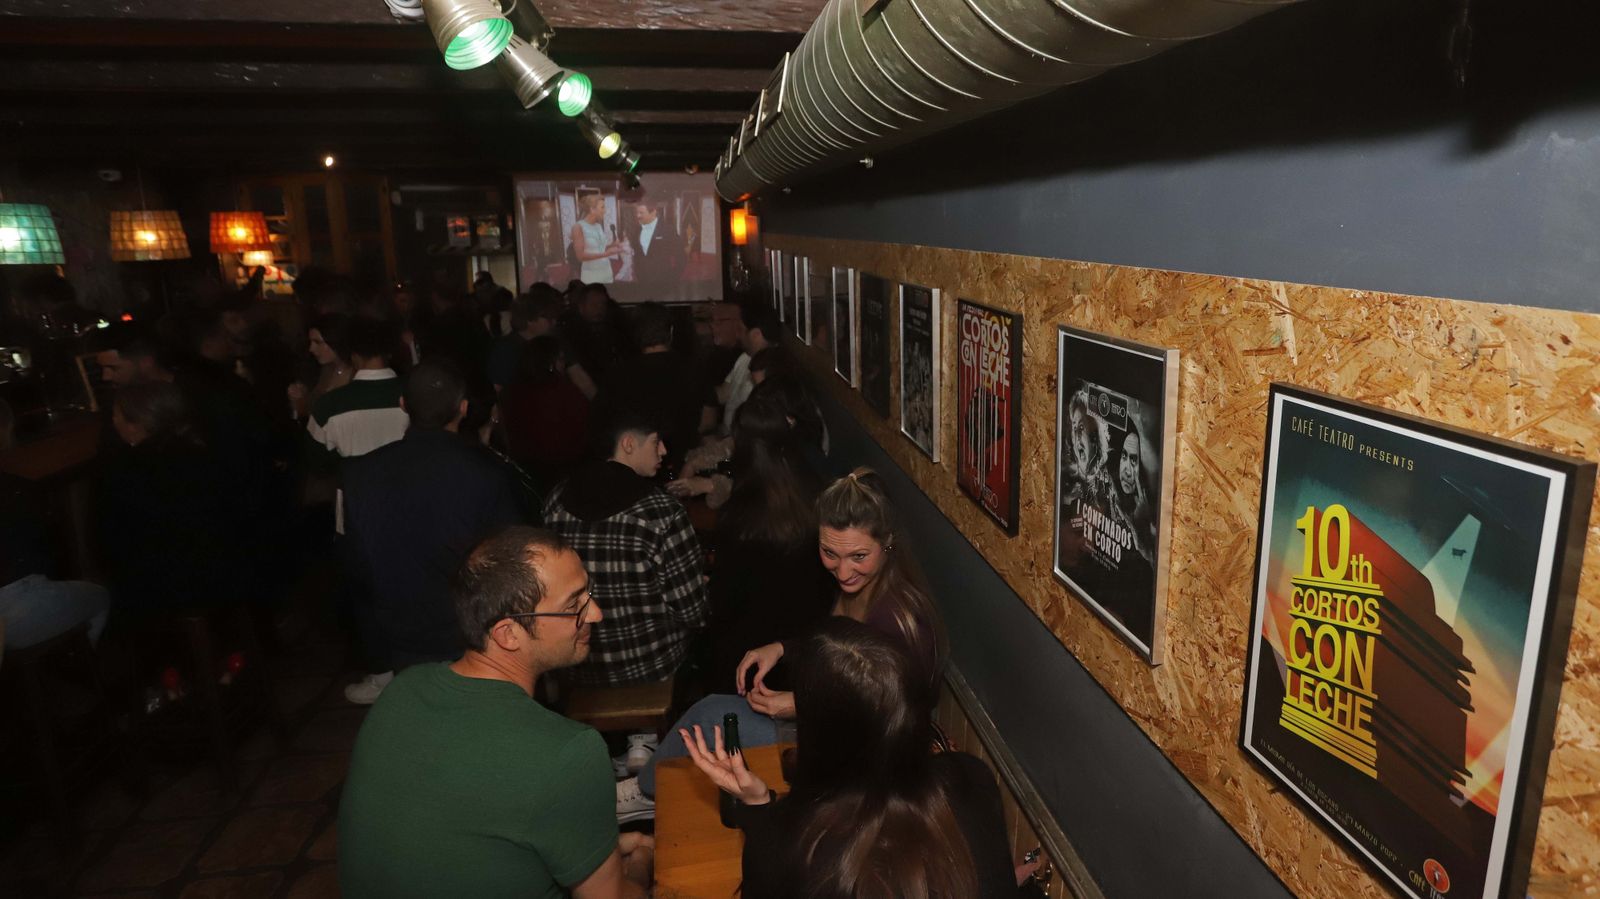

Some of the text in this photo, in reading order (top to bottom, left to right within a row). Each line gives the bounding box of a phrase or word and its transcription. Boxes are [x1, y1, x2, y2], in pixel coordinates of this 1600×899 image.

[962, 313, 1009, 356] CORTOS
[961, 339, 1010, 387] CON LECHE
[1291, 416, 1414, 471] CAFÉ TEATRO PRESENTS
[1076, 498, 1132, 550] I CONFINADOS
[1083, 520, 1093, 542] EN
[1095, 530, 1121, 563] CORTO
[1296, 503, 1373, 585] 10th
[1290, 586, 1380, 631] CORTOS
[1289, 617, 1376, 698] CON
[1285, 668, 1374, 741] LECHE
[1354, 820, 1378, 846] MARZO
